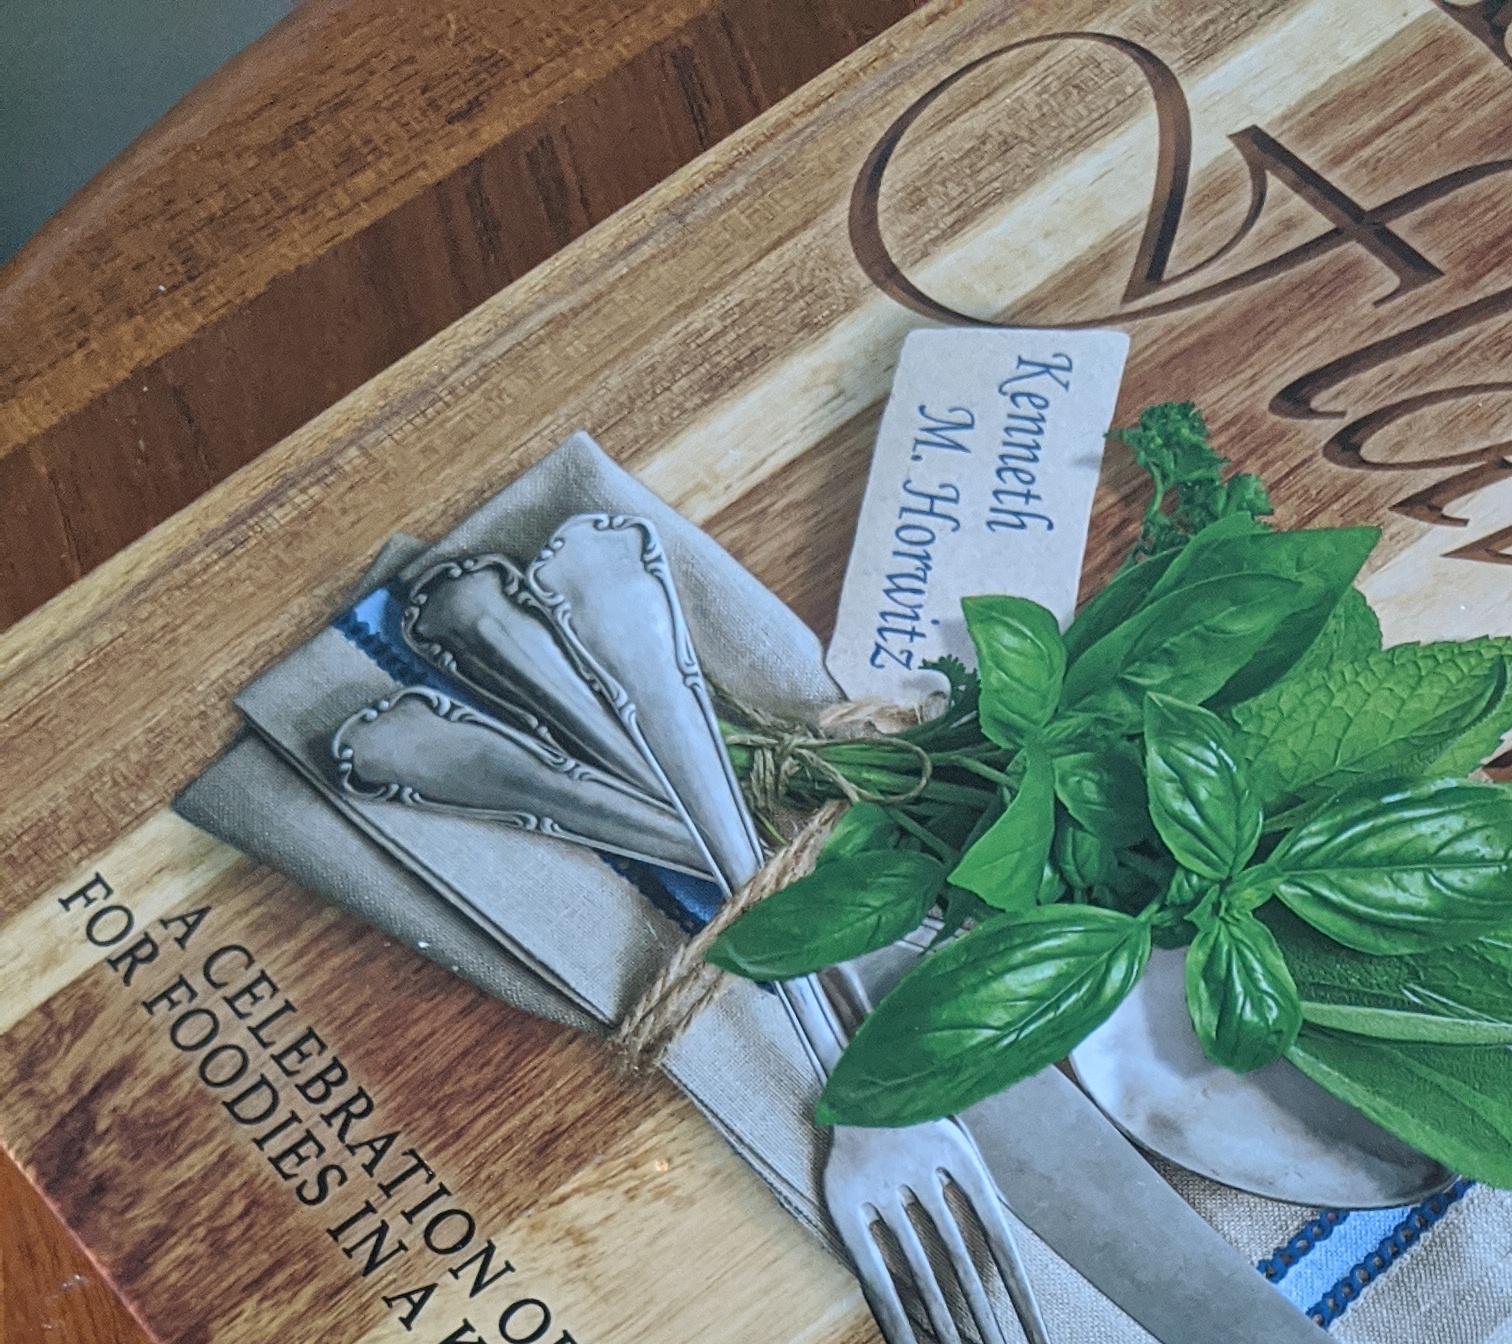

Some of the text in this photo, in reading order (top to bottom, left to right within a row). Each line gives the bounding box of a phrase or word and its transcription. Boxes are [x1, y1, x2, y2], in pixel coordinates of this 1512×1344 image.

[869, 405, 976, 672] M. Horwitz
[985, 353, 1074, 533] Kenneth
[57, 871, 160, 987] FOR
[140, 974, 348, 1206] FOODIES
[325, 1200, 409, 1278] IN
[381, 1281, 440, 1332] A
[160, 905, 213, 950] A
[202, 943, 516, 1299] CELEBRATION
